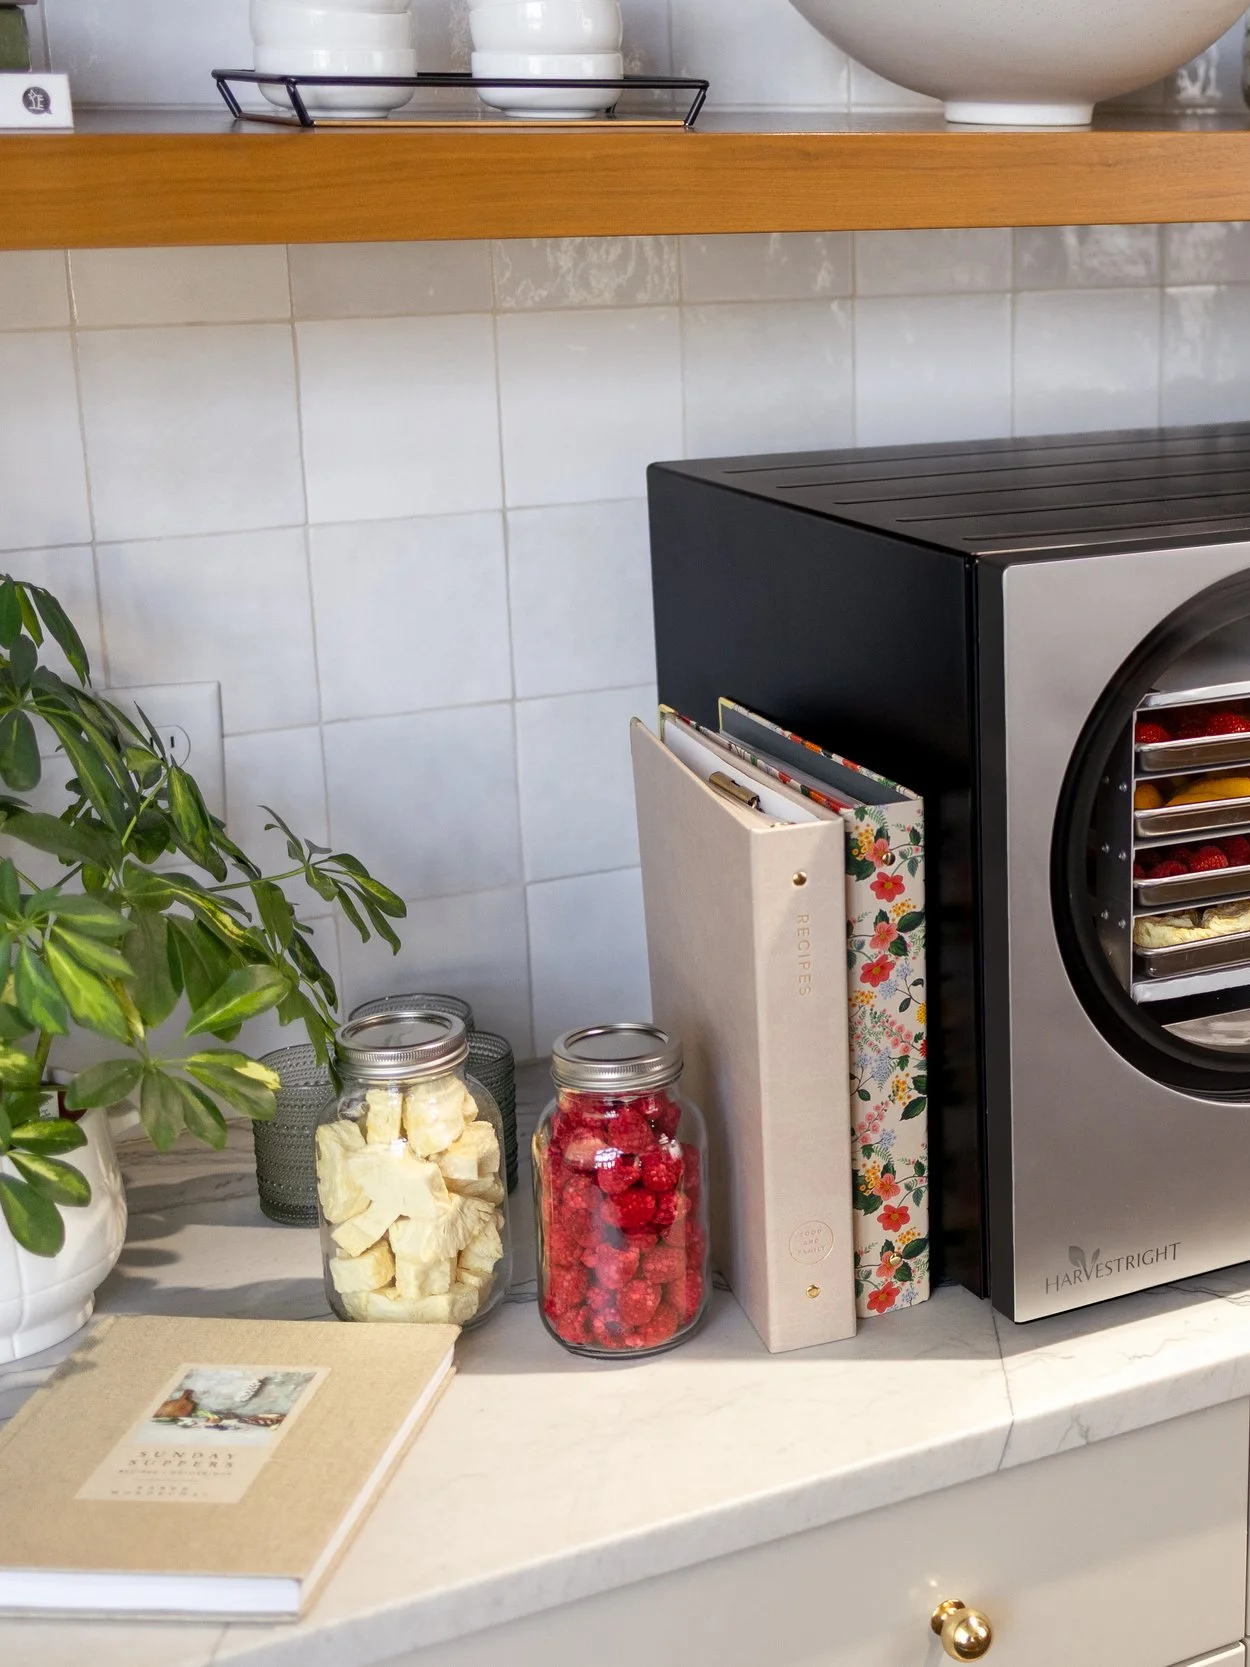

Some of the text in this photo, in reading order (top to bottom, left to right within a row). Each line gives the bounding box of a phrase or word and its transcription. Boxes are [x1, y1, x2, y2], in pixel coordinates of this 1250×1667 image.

[796, 914, 812, 997] RECIPES
[1045, 1242, 1181, 1294] HARVESTRIGHT
[127, 1459, 235, 1468] SUPPERS
[139, 1451, 236, 1459] SUNDAY
